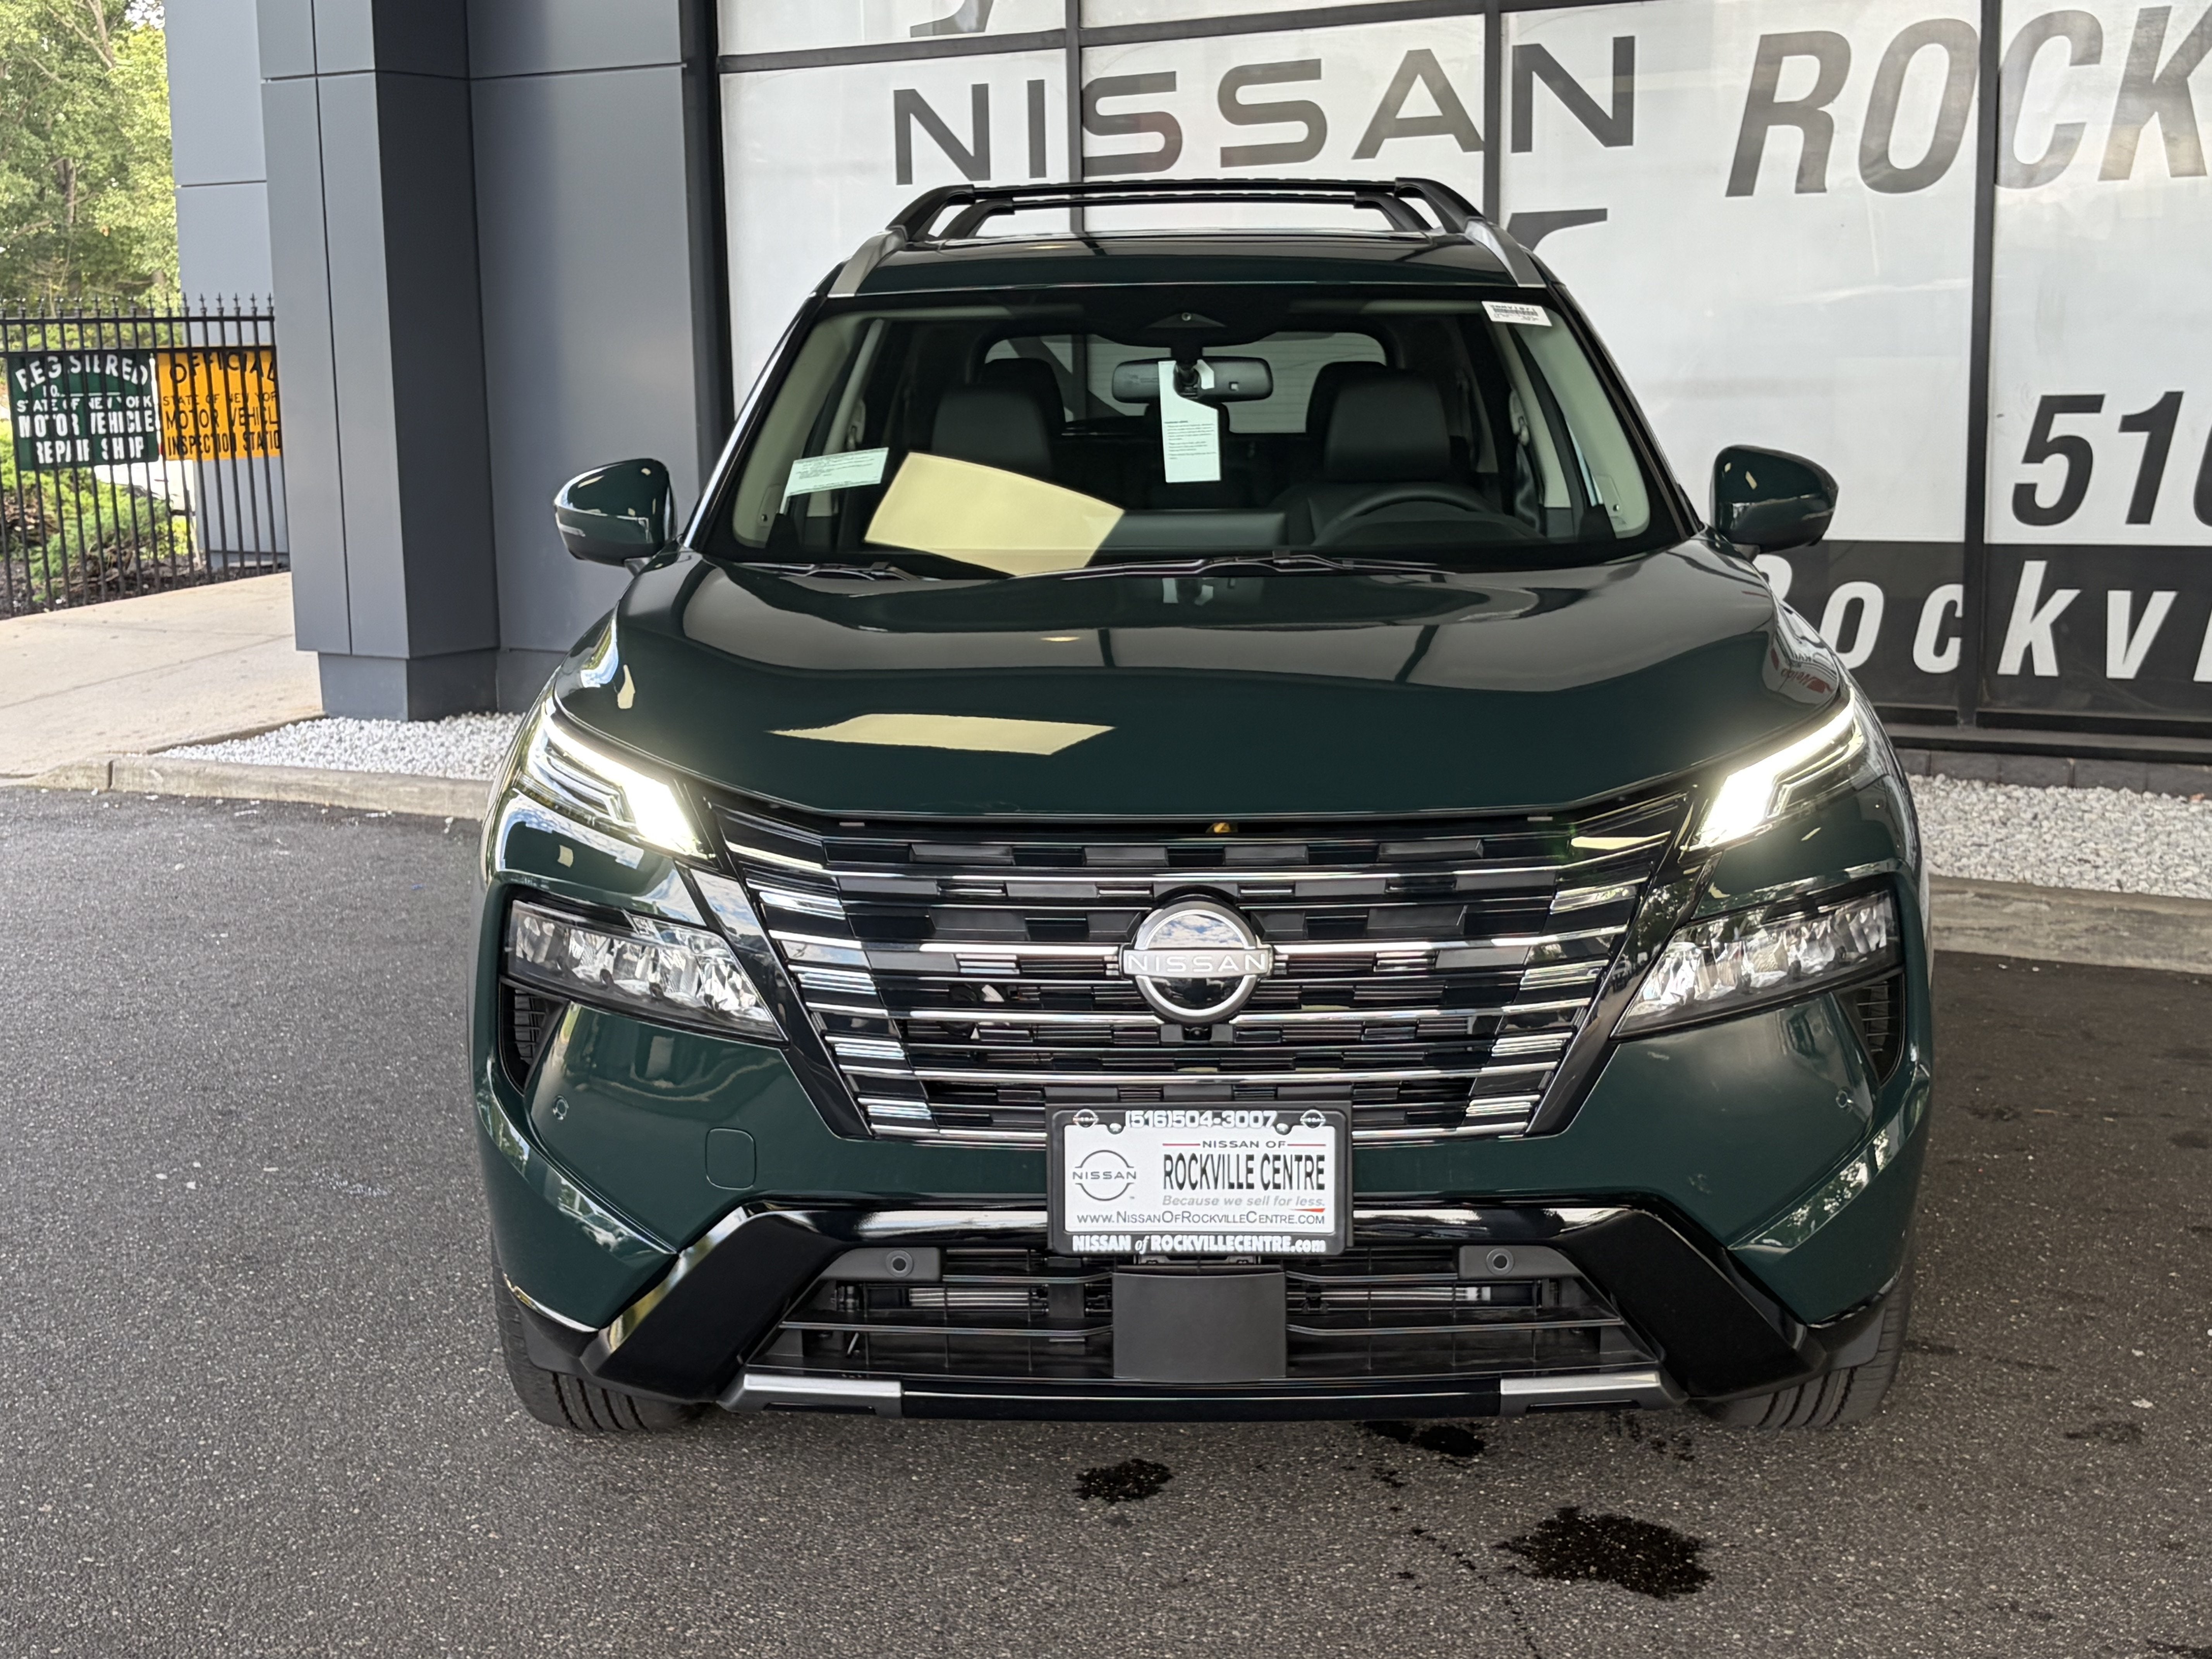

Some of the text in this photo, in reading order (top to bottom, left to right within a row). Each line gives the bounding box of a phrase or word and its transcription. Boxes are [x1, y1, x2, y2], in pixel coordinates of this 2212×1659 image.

[894, 36, 1635, 185] NISSAN
[1725, 5, 2212, 197] ROCK
[15, 354, 148, 392] REGSTERED
[2012, 390, 2212, 528] 51
[1127, 953, 1266, 972] NISSAN
[1125, 1110, 1278, 1128] (516)504-3007
[1202, 1140, 1286, 1149] NISSAN OF
[1072, 1171, 1137, 1180] NISSAN
[1163, 1152, 1325, 1191] ROCKVILLE CENTRE
[1162, 1195, 1325, 1206] Because we sell for less.
[1072, 1235, 1327, 1255] NISSAN of ROCKVILLECENTRE.com
